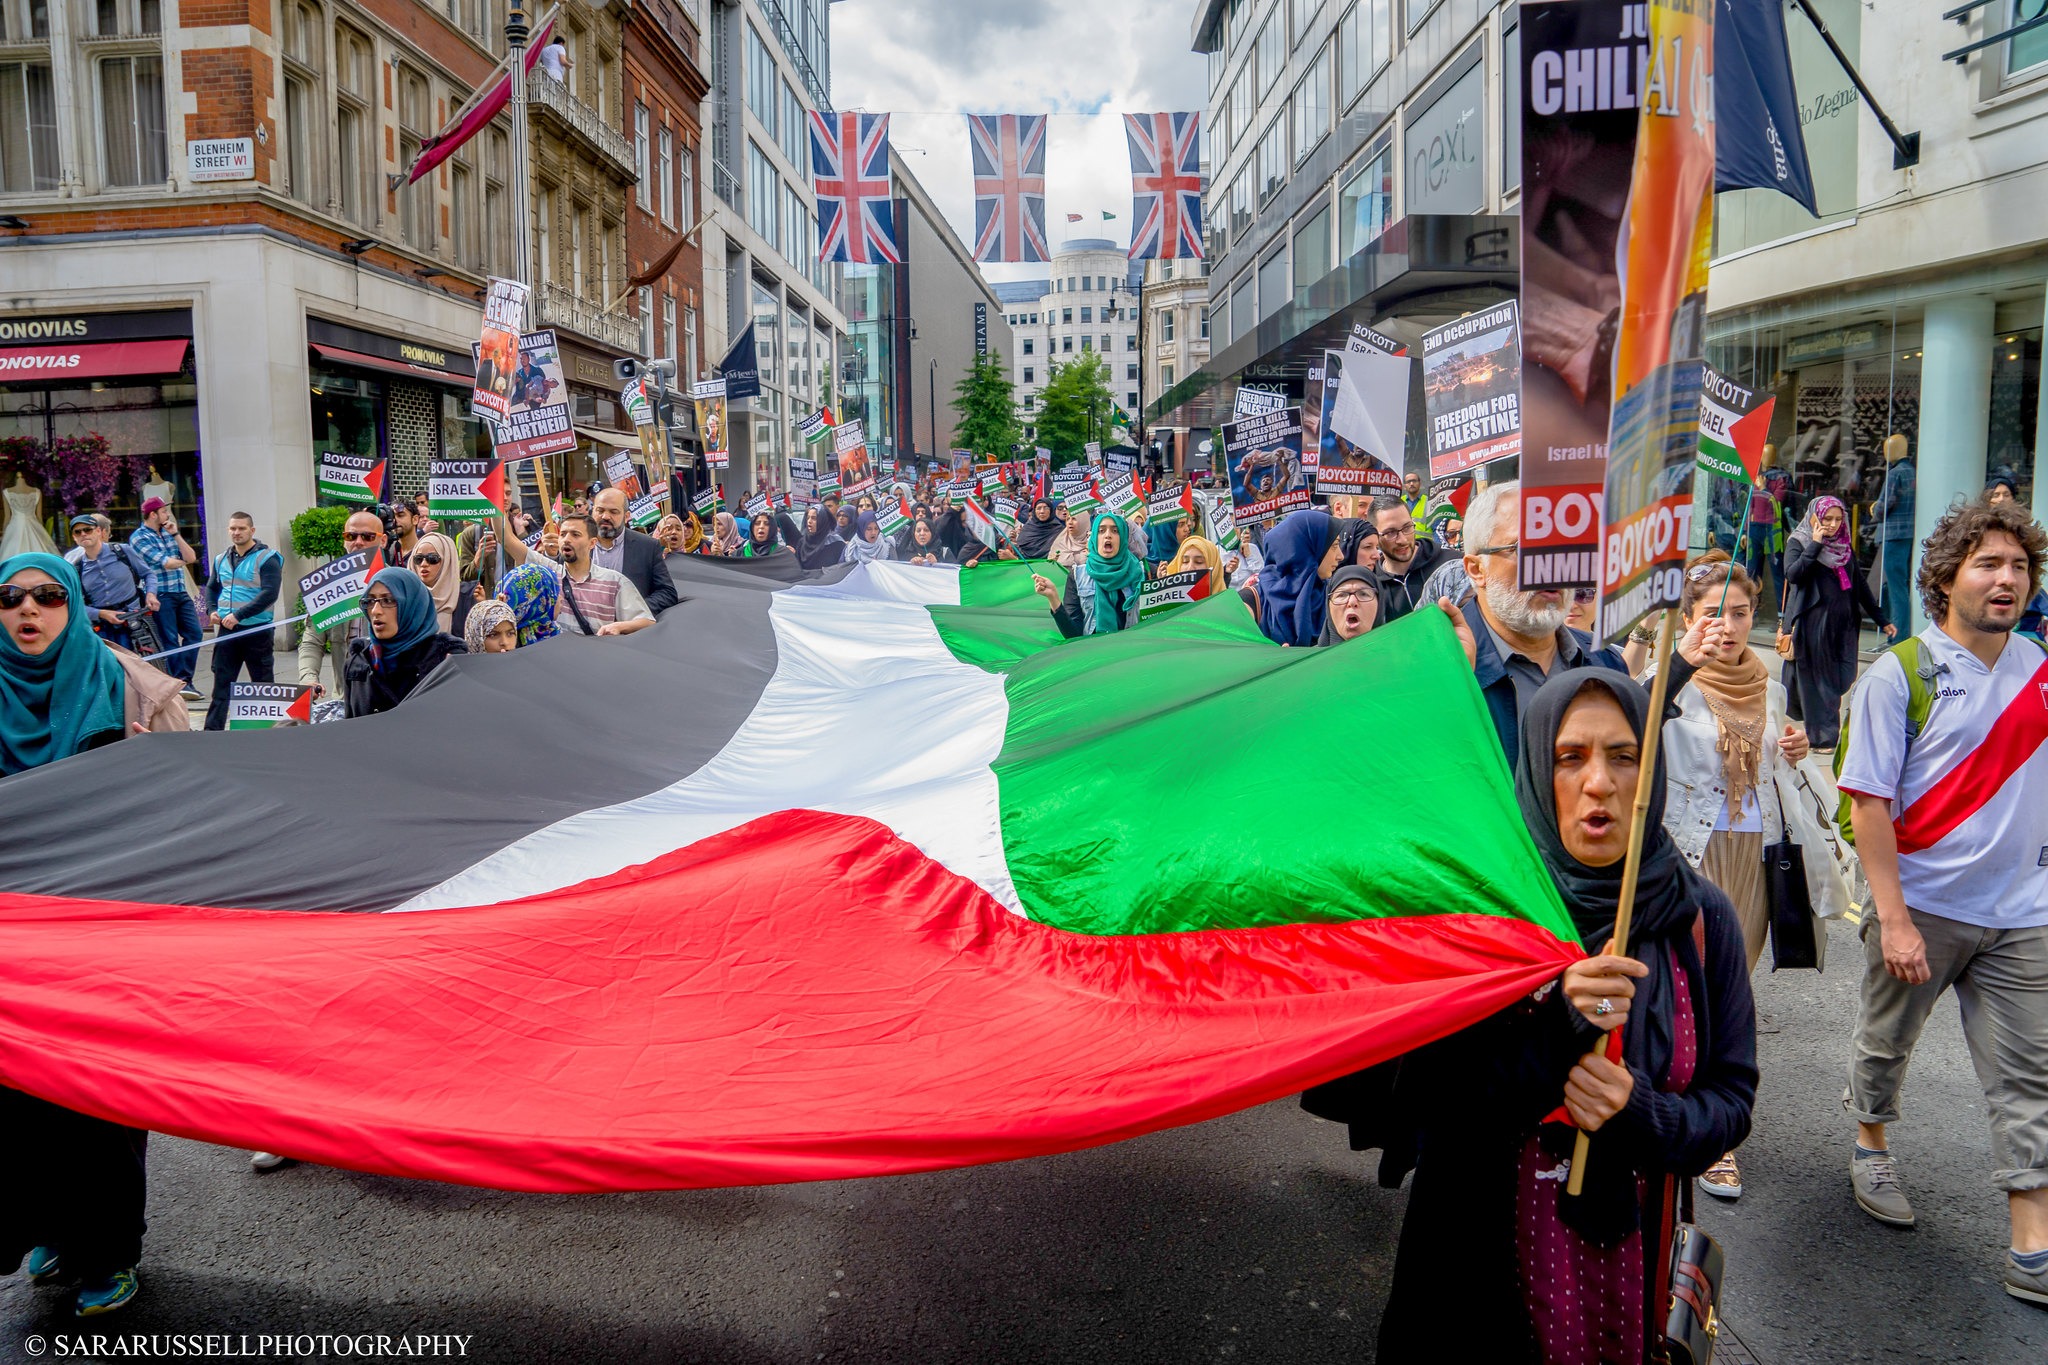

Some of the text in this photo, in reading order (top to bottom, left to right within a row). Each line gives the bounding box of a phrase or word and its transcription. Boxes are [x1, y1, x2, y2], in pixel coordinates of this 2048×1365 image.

[1814, 85, 1858, 118] Zegna
[194, 142, 244, 155] BLENHEIM
[1414, 107, 1475, 206] next
[195, 156, 246, 168] STREET W1
[494, 282, 510, 299] STOP
[1354, 324, 1397, 351] BOYCOTT
[1423, 308, 1512, 352] END OCCUPATION
[401, 344, 446, 366] PRONOVIAS
[475, 389, 503, 410] BOYCOTT
[1240, 392, 1284, 408] FREEDOM TO
[511, 404, 566, 426] THE ISRAELI
[799, 411, 823, 428] BOYCOTT
[1434, 394, 1518, 432] FREEDOM FOR
[498, 416, 568, 444] APARTHEID
[1237, 411, 1289, 433] ISRAEL KILLS
[1235, 420, 1290, 441] ONE PALESTINIAN
[1435, 409, 1520, 452] PALESTINE
[529, 436, 572, 452] www.ihrc.org
[1227, 426, 1302, 452] CHILD EVERY 60 HOURS
[324, 452, 374, 468] BOYCOTT
[1548, 445, 1591, 461] Israel
[431, 462, 488, 474] BOYCOTT
[326, 470, 361, 483] ISRAEL
[1099, 473, 1132, 496] BOYCOTT
[1319, 468, 1401, 487] BOYCOTT ISRAEL
[433, 484, 475, 495] ISRAEL
[693, 484, 718, 502] BOYCOT
[1064, 482, 1090, 496] BOYCOTT
[1151, 486, 1182, 502] BOYCOTT
[1318, 483, 1400, 496] INMINDS.COM IHRC.ORG
[629, 495, 652, 511] BOYCOT
[997, 498, 1018, 508] BOYCOTT
[1068, 494, 1088, 504] ISRAEL
[1110, 490, 1133, 506] ISRAEL
[1235, 492, 1308, 517] BOYCOTT ISRAEL
[874, 501, 900, 519] BOYCOTT
[1153, 501, 1177, 513] ISRAEL
[1212, 506, 1226, 522] BOYC
[881, 513, 899, 526] ISRAEL
[1237, 511, 1275, 525] INMINDS.COM
[301, 552, 367, 591] BOYCOTT
[1143, 572, 1196, 592] BOYCOTT
[313, 579, 363, 608] ISRAEL
[1146, 591, 1185, 606] ISRAEL
[234, 686, 297, 698] BOYCOTT
[237, 706, 283, 716] ISRAEL
